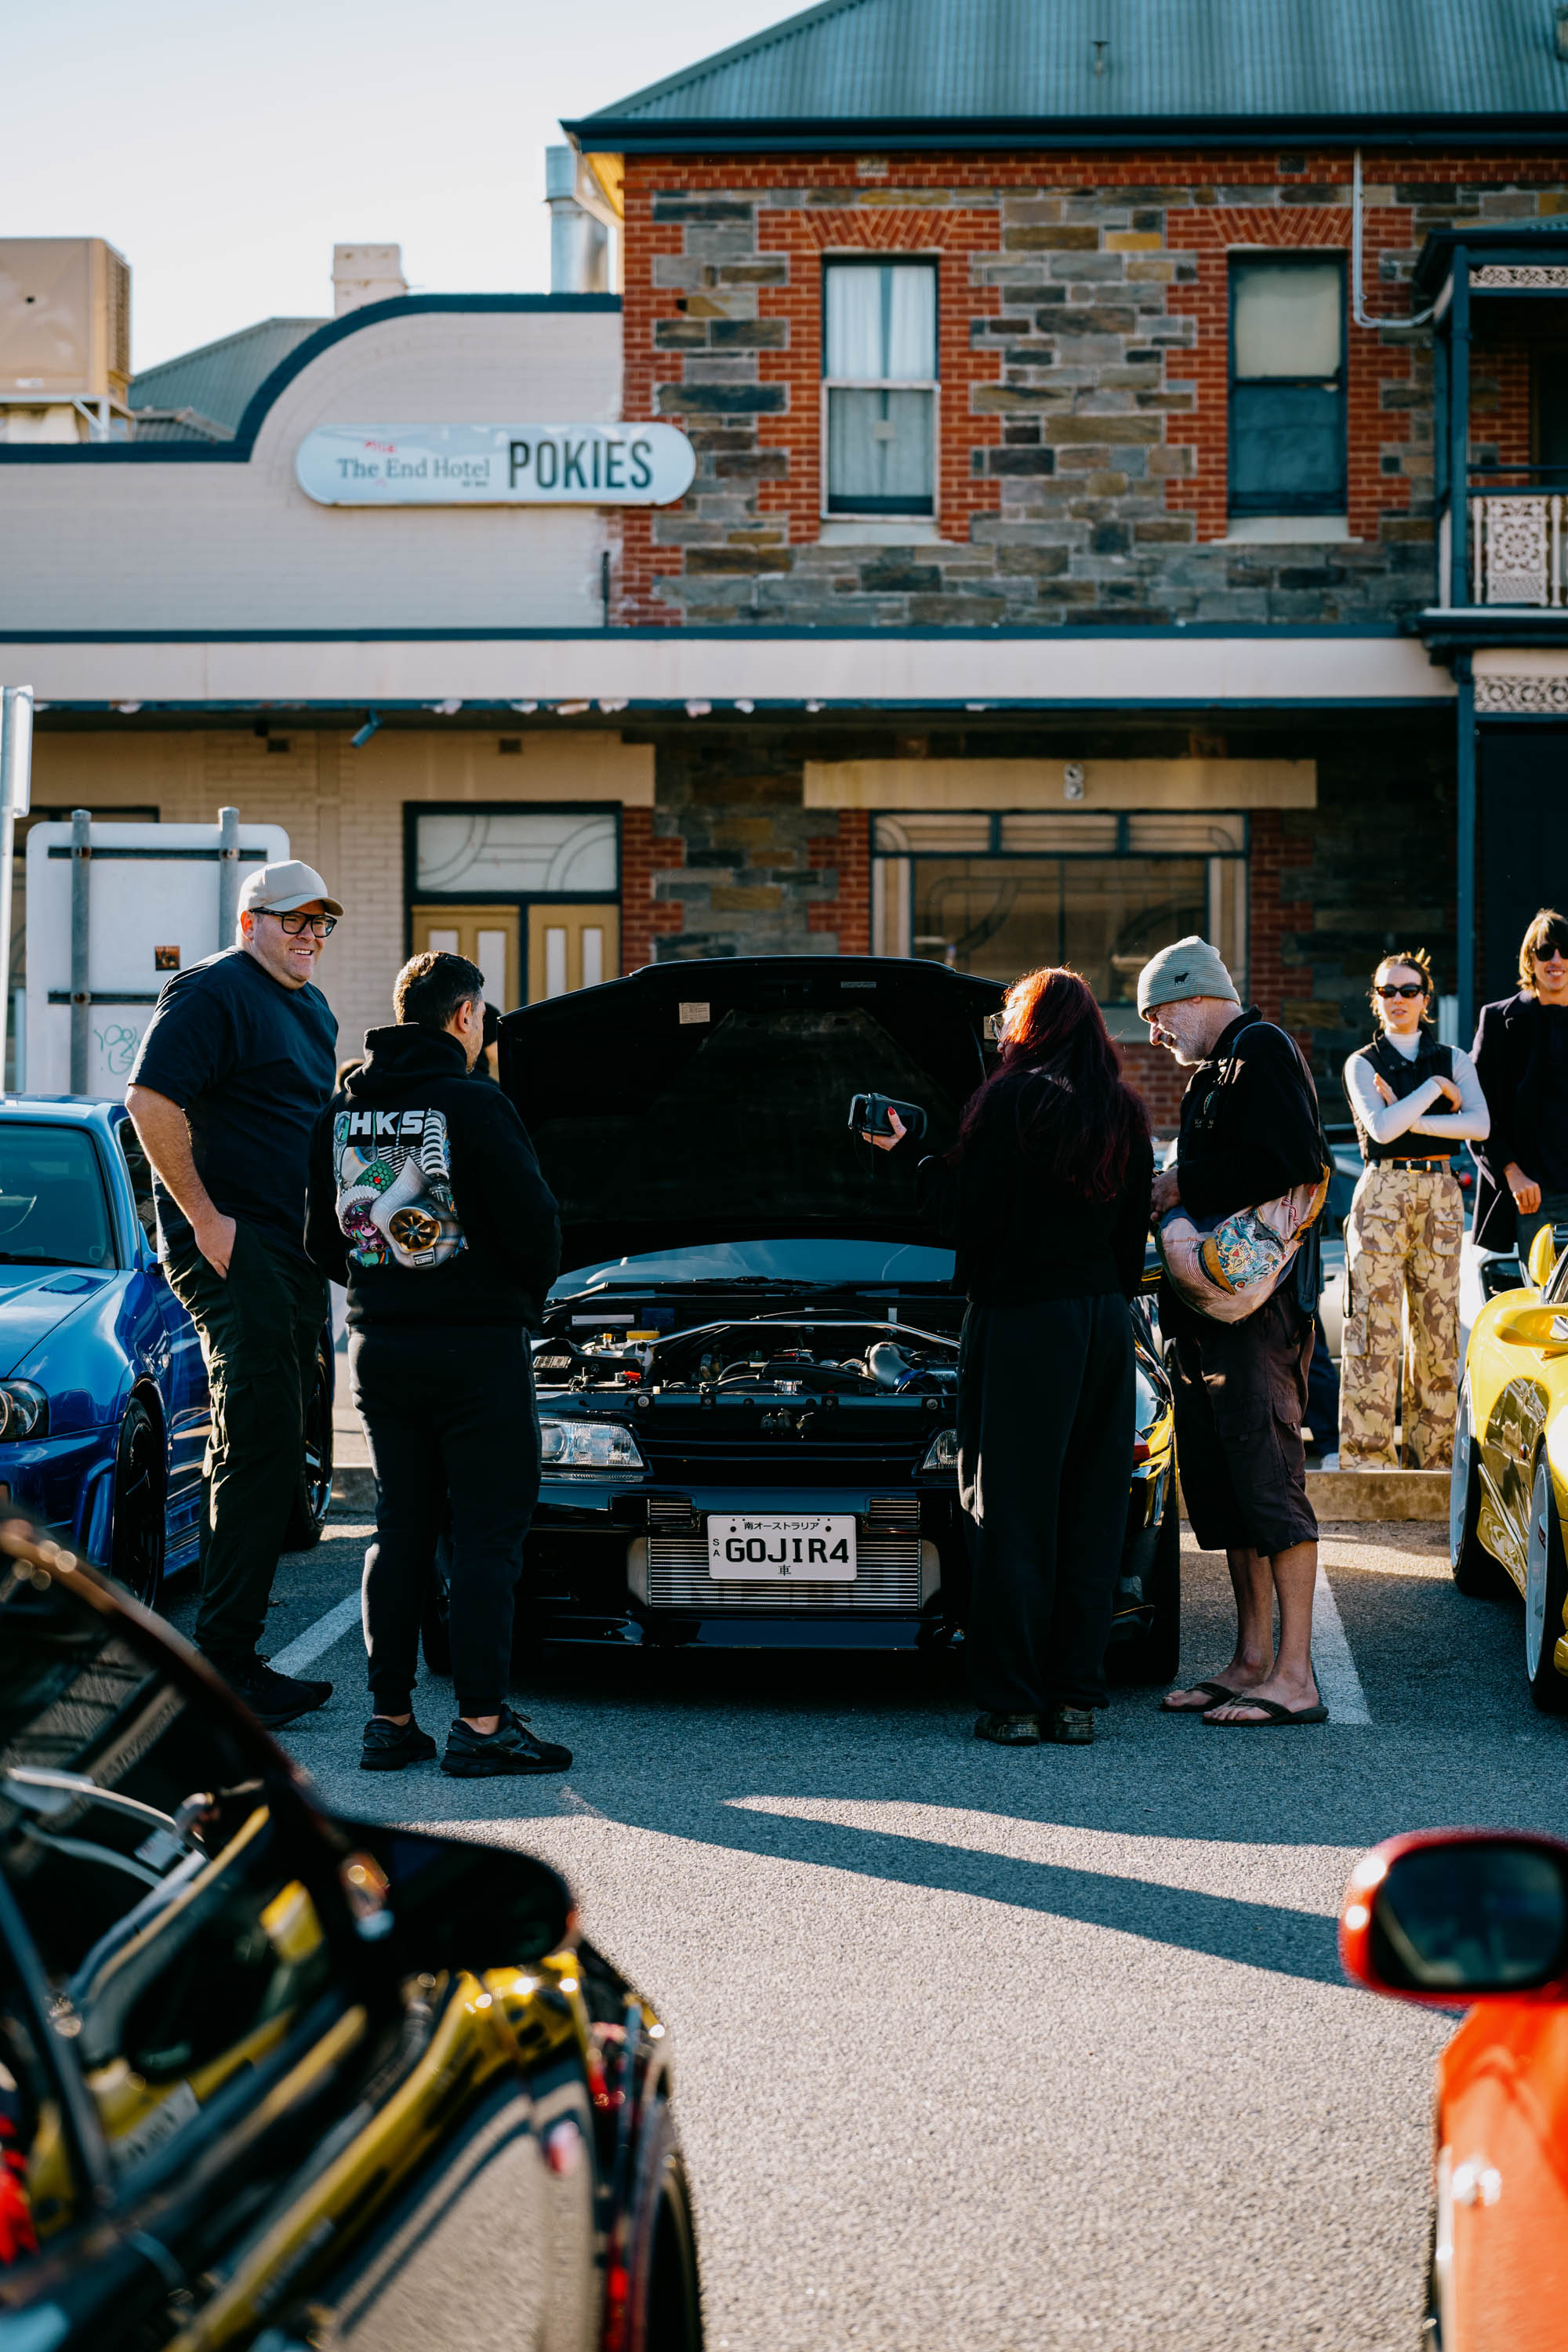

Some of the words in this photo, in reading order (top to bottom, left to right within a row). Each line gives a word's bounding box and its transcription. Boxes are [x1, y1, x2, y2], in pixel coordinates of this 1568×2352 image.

[337, 458, 379, 479] The
[386, 458, 428, 479] End
[433, 458, 491, 479] Hotel
[509, 440, 653, 488] POKIES
[350, 1110, 425, 1135] HKS
[744, 1522, 819, 1530] 南オーストラリア
[725, 1537, 849, 1563] GOJIR4
[778, 1564, 792, 1577] 車
